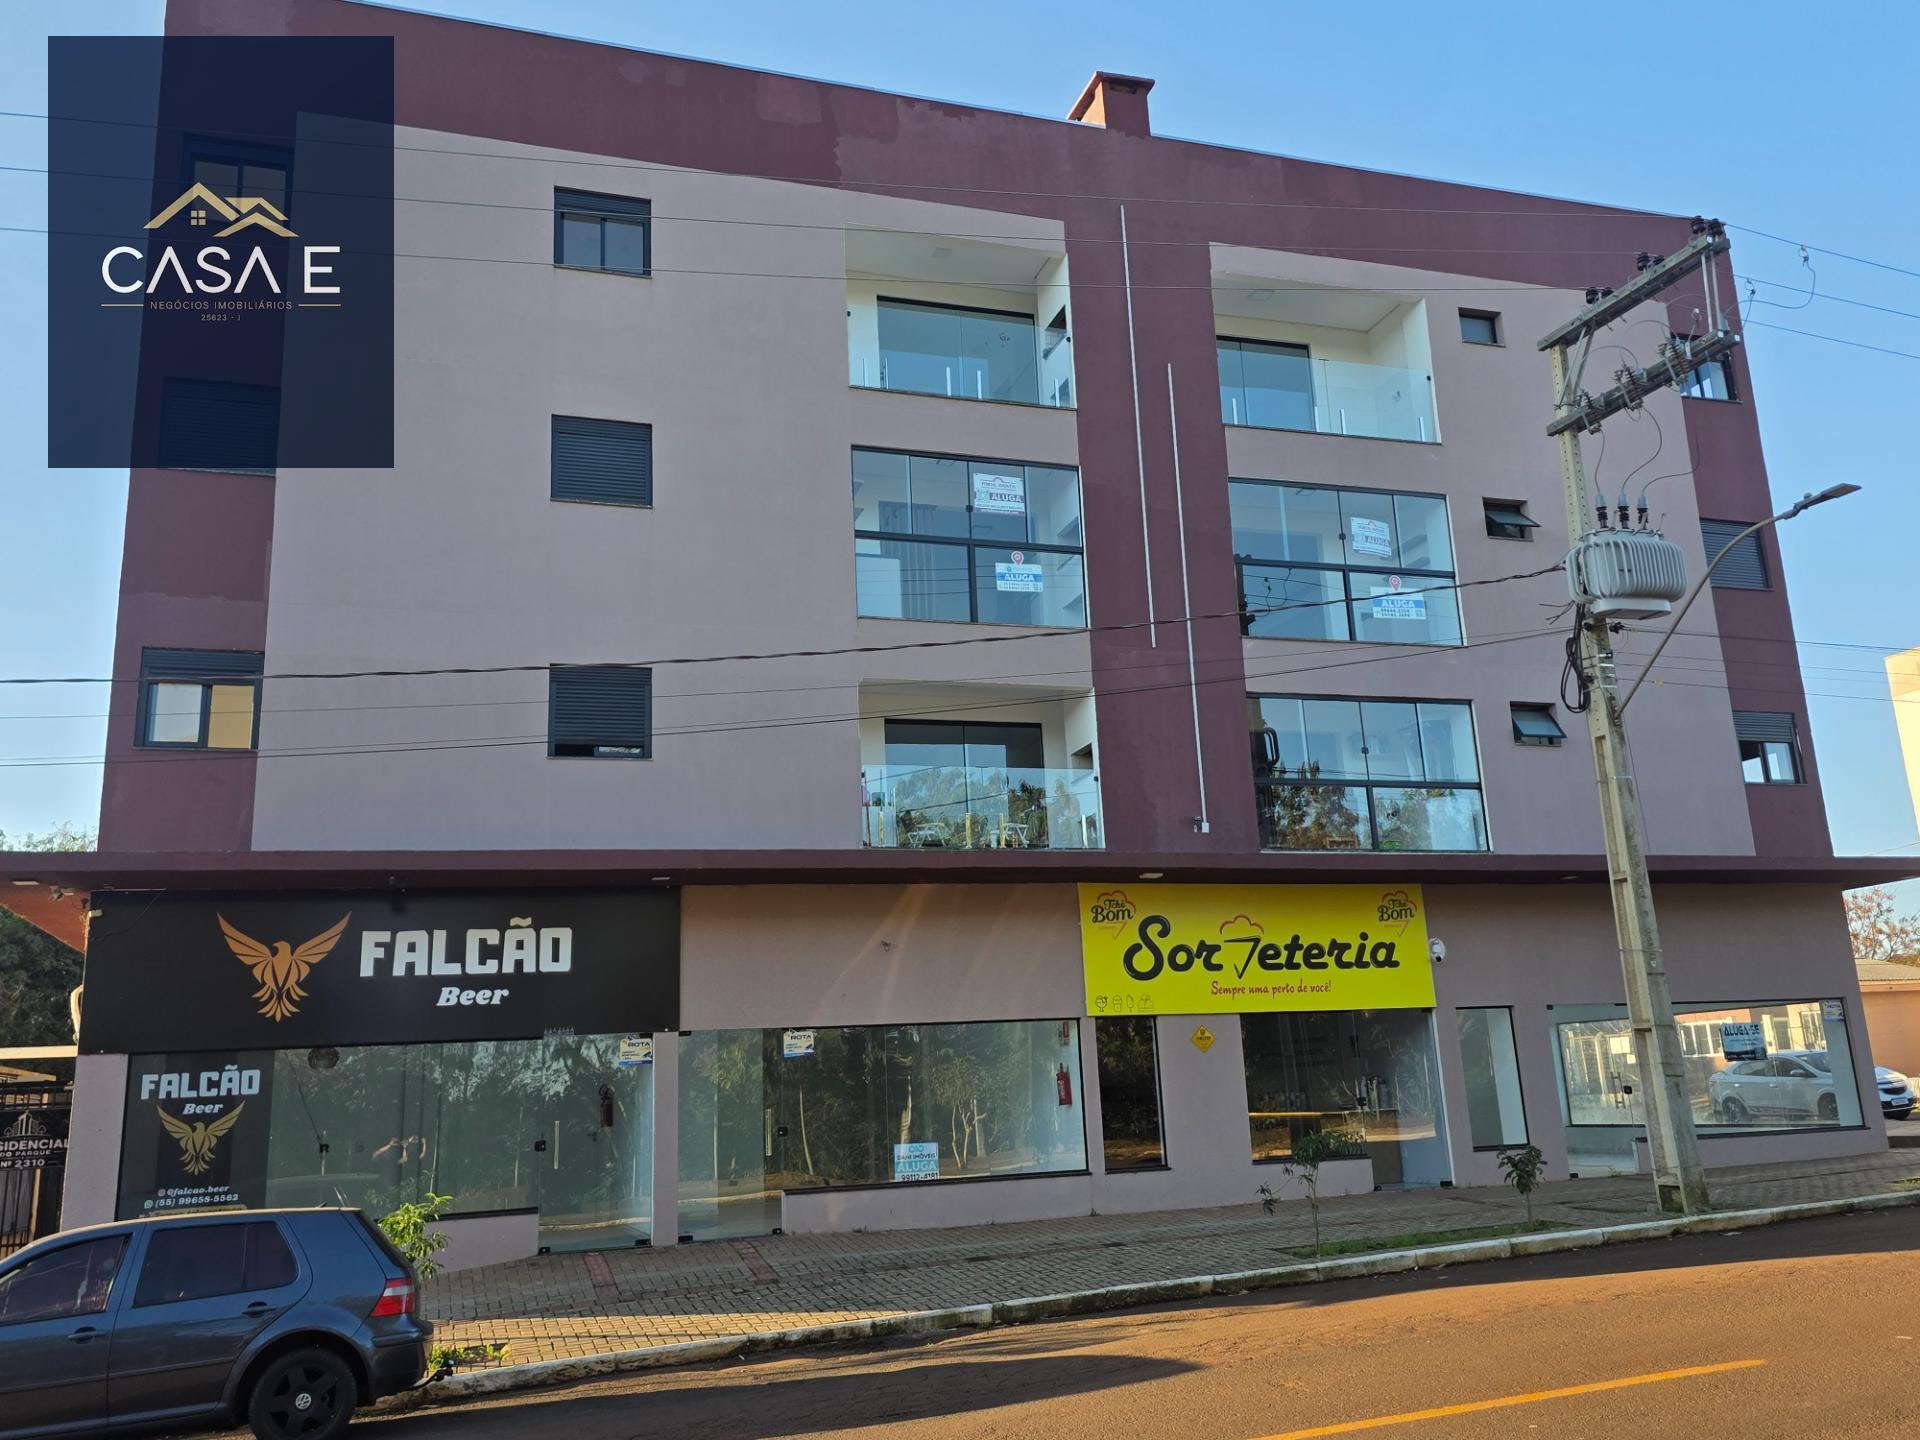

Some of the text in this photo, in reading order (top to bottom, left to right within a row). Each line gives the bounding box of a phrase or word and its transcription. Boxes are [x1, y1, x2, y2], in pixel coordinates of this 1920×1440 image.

[991, 493, 1022, 503] ALUGA
[1004, 573, 1036, 581] ALUGA
[1381, 599, 1414, 608] ALUGA
[1091, 904, 1134, 923] Bom
[1377, 904, 1415, 921] Bom
[359, 916, 573, 977] FALCÃO
[1211, 978, 1332, 1000] Sempre uma perto de você!
[436, 986, 510, 1007] Beer
[141, 1064, 261, 1100] FALCÃO
[182, 1103, 224, 1115] Beer
[15, 1149, 52, 1157] PARQUE
[14, 1158, 46, 1168] 2310
[897, 1160, 938, 1172] ALUGA
[166, 1185, 230, 1198] @falcao.beer
[155, 1198, 176, 1209] (55)
